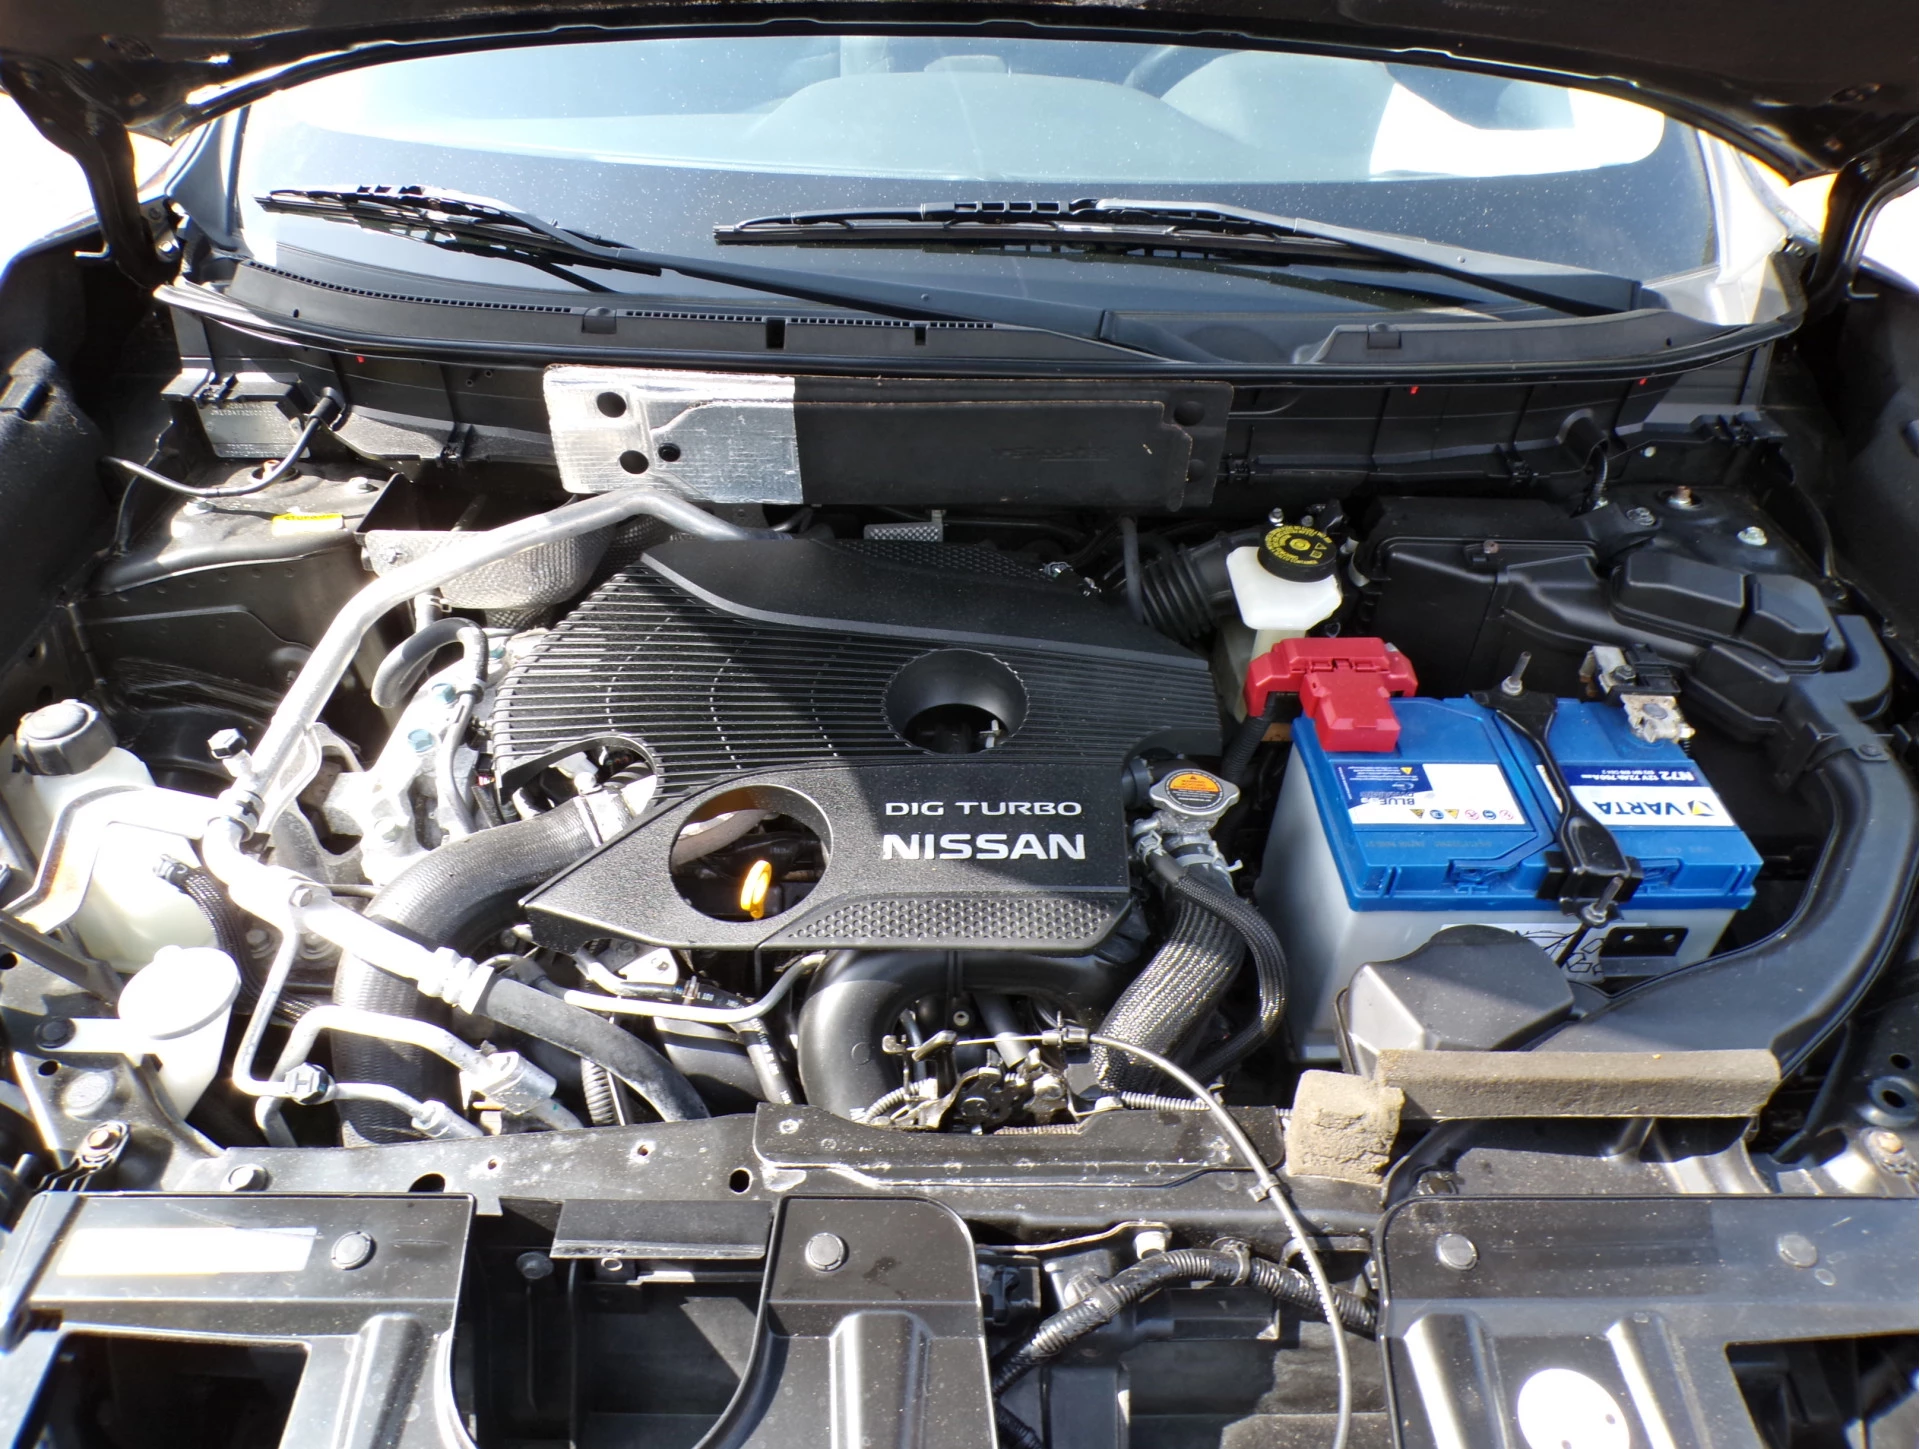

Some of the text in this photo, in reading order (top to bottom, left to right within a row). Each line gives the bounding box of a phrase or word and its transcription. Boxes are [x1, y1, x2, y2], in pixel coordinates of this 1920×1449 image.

[885, 801, 1083, 816] DIG TURBO
[1593, 801, 1686, 816] VARTA
[882, 833, 1087, 860] NISSAN
